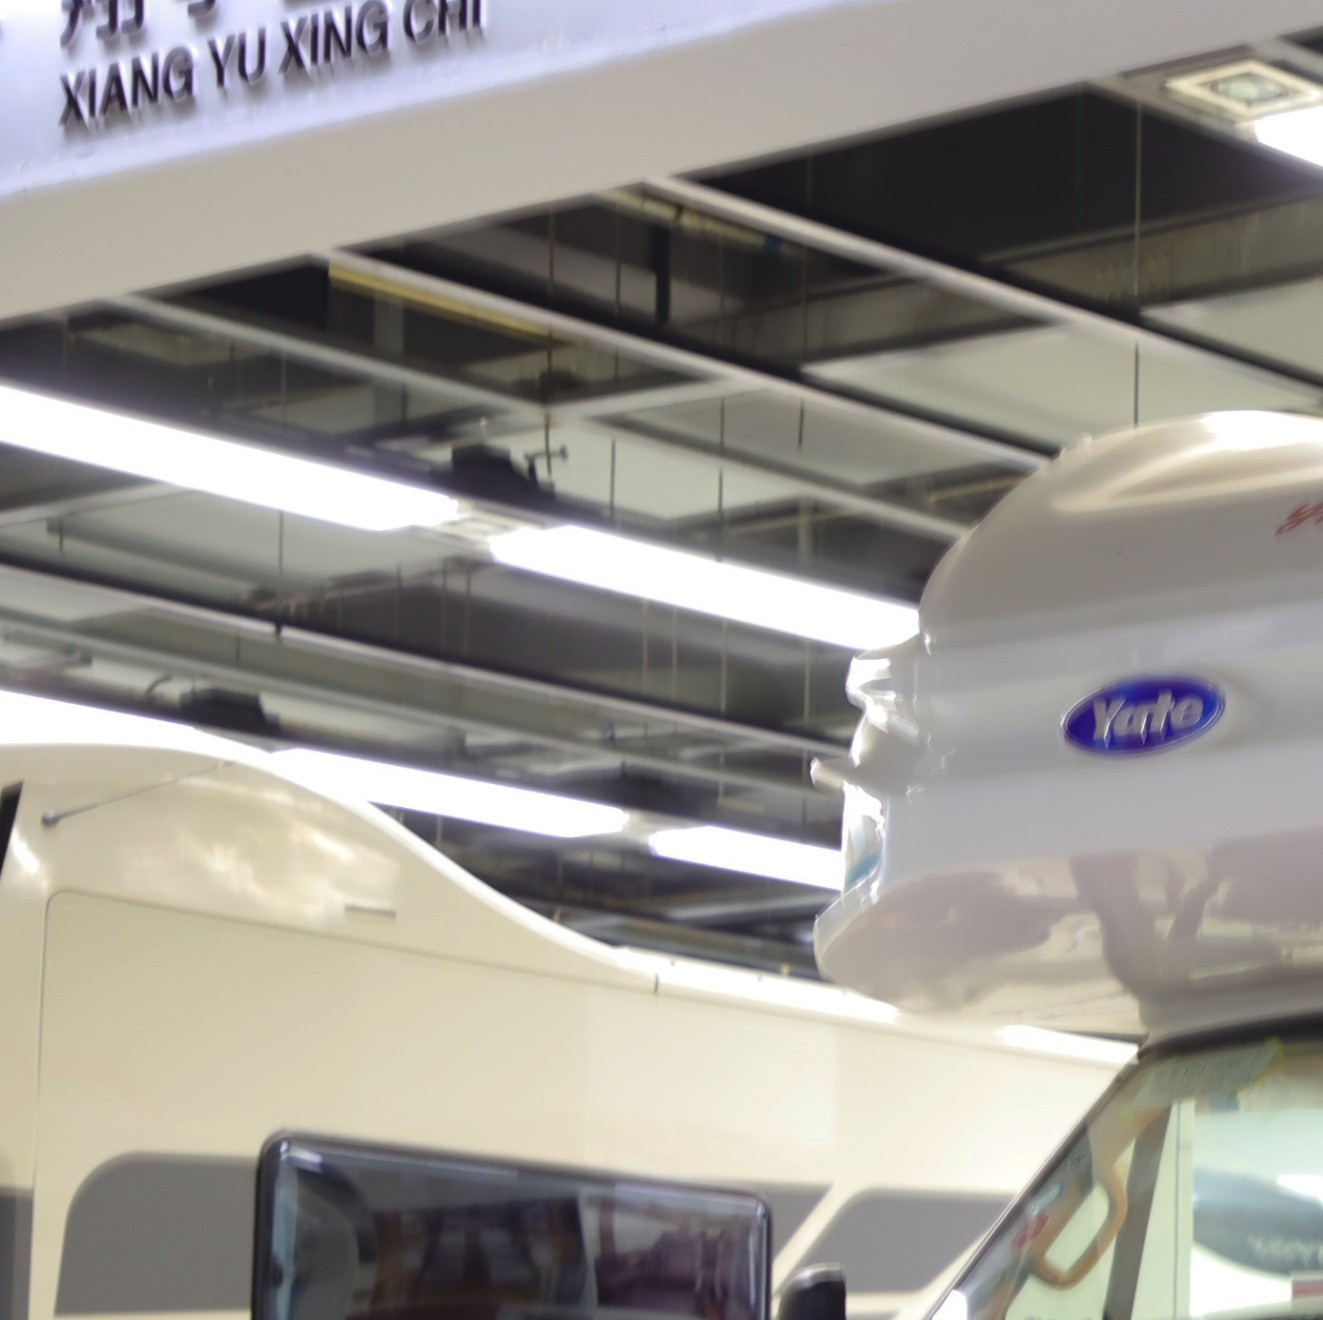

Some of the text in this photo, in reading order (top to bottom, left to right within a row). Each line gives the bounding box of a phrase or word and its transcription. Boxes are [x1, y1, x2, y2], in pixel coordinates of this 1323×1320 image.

[59, 46, 197, 131] XIANG
[207, 26, 268, 89] YU
[279, 0, 391, 76] XING
[402, 0, 487, 45] CHI
[1092, 689, 1205, 748] Yate
